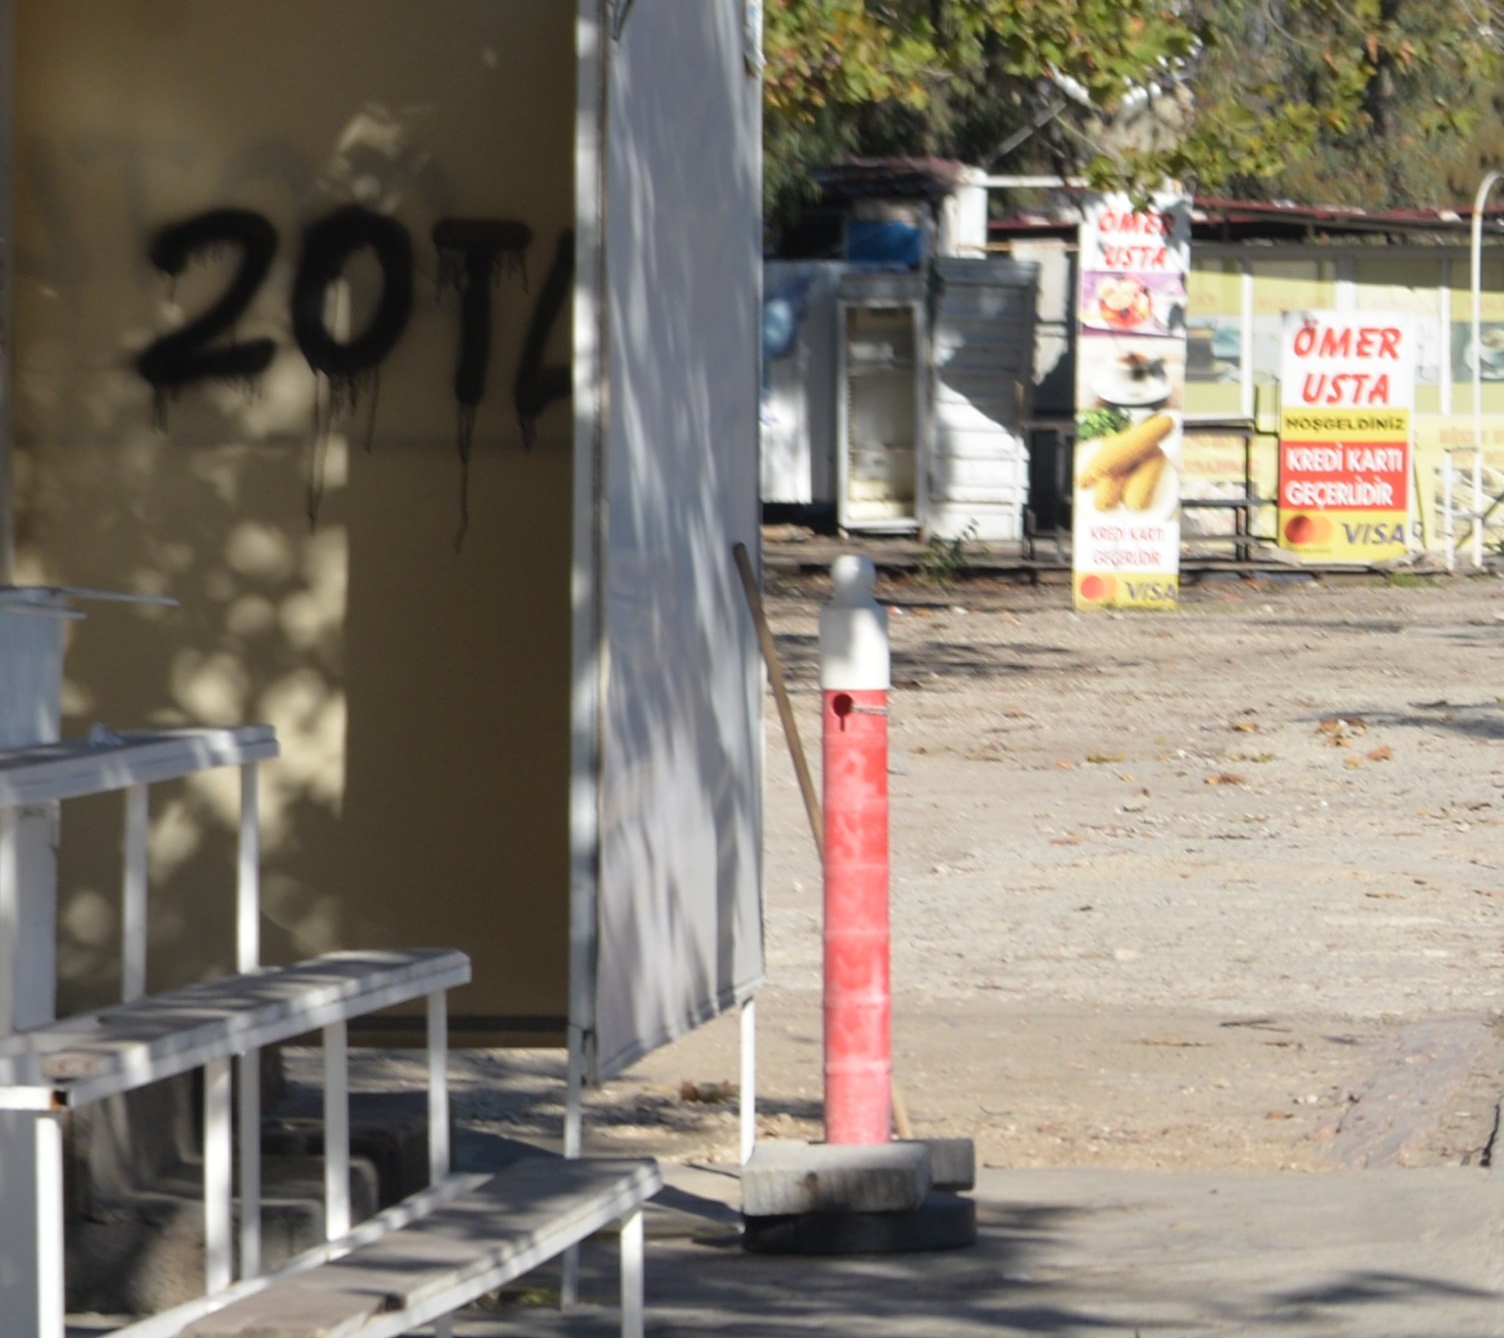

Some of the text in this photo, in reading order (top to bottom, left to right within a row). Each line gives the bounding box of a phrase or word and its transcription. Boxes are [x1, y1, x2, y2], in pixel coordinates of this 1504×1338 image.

[1104, 245, 1169, 269] USTA
[1294, 319, 1402, 358] ÖMER
[1303, 372, 1390, 404] USTA
[1285, 415, 1406, 432] HOŞGELDİNİZ
[1286, 442, 1404, 472] KREDİ KARTI
[1285, 475, 1395, 510] GEÇERLİDİR
[1342, 522, 1407, 545] VISA
